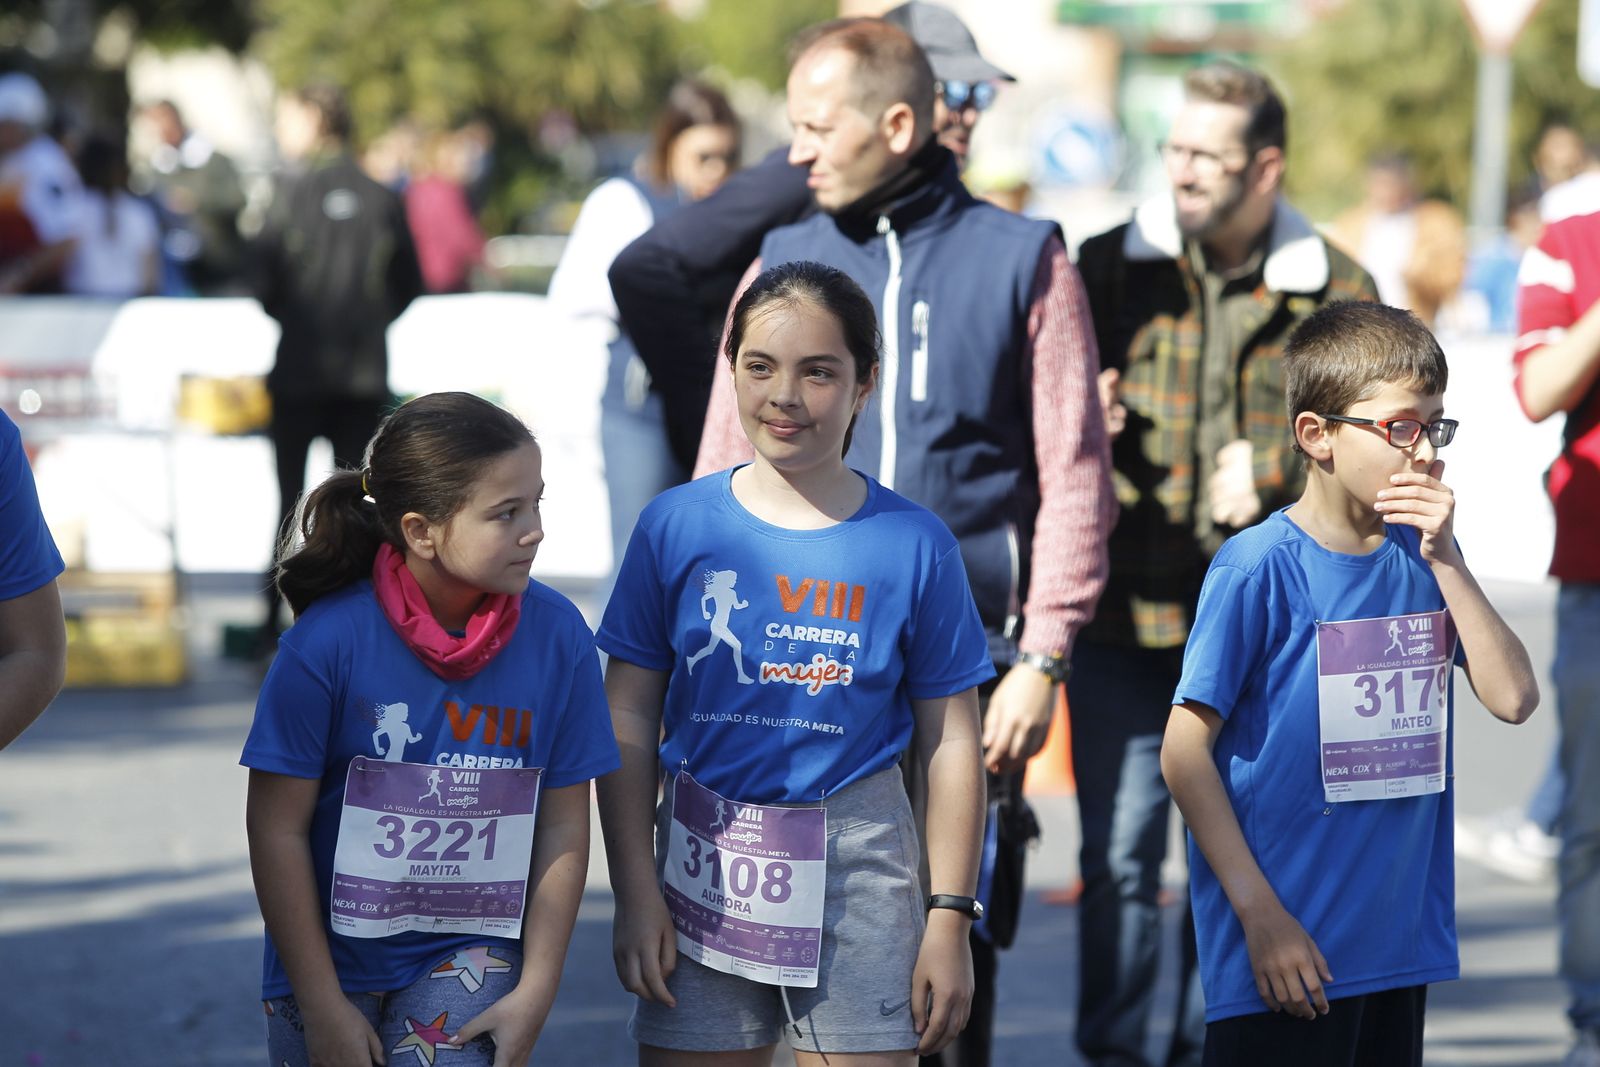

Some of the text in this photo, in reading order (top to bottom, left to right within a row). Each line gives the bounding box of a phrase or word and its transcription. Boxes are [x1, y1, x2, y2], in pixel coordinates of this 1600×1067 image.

[775, 574, 866, 622] VIII
[1407, 617, 1432, 632] VIII
[765, 622, 860, 648] CARRERA
[764, 640, 856, 661] DE LA
[1367, 660, 1400, 669] IGUALDAD
[1353, 665, 1447, 719] 3179
[443, 701, 533, 747] VIII
[745, 714, 759, 725] ES
[762, 716, 810, 730] NUESTRA
[811, 721, 844, 735] META
[1391, 714, 1433, 731] MATEO
[451, 771, 481, 785] VIII
[1325, 765, 1349, 777] NEXA
[1352, 763, 1371, 774] CDX
[383, 803, 393, 811] LA
[395, 805, 437, 816] IGUALDAD
[482, 808, 502, 816] META
[733, 805, 764, 822] VIII
[731, 820, 763, 830] CARRERA
[373, 814, 499, 862] 3221
[732, 844, 768, 856] NUESTRA
[408, 864, 461, 876] MAYITA
[683, 835, 793, 904] 3108
[333, 898, 356, 911] NEXA
[359, 902, 381, 913] CDX
[701, 888, 753, 915] AURORA
